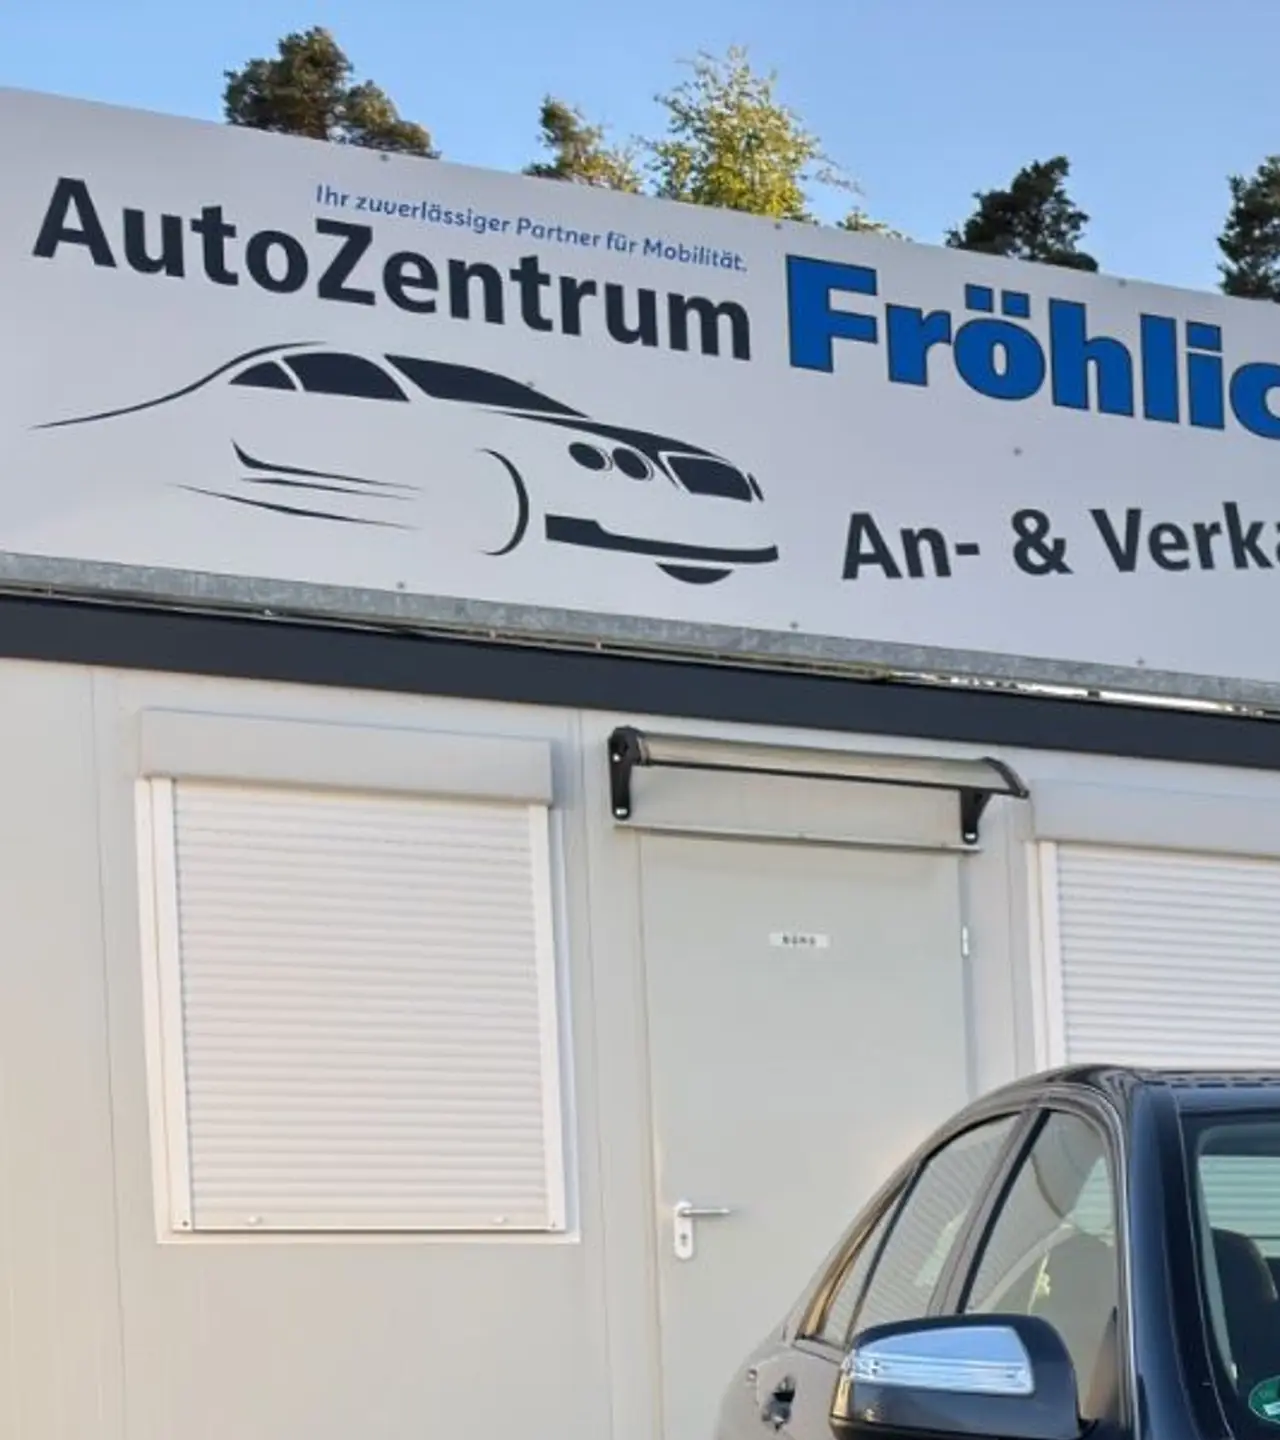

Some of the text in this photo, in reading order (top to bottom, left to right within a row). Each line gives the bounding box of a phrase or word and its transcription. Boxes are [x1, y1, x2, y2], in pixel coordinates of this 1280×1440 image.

[32, 176, 751, 361] AutoZentrum
[316, 184, 749, 273] Ihr zuverlässiger Partner für Mobilität.
[842, 511, 980, 580] An-
[1011, 507, 1073, 575] &
